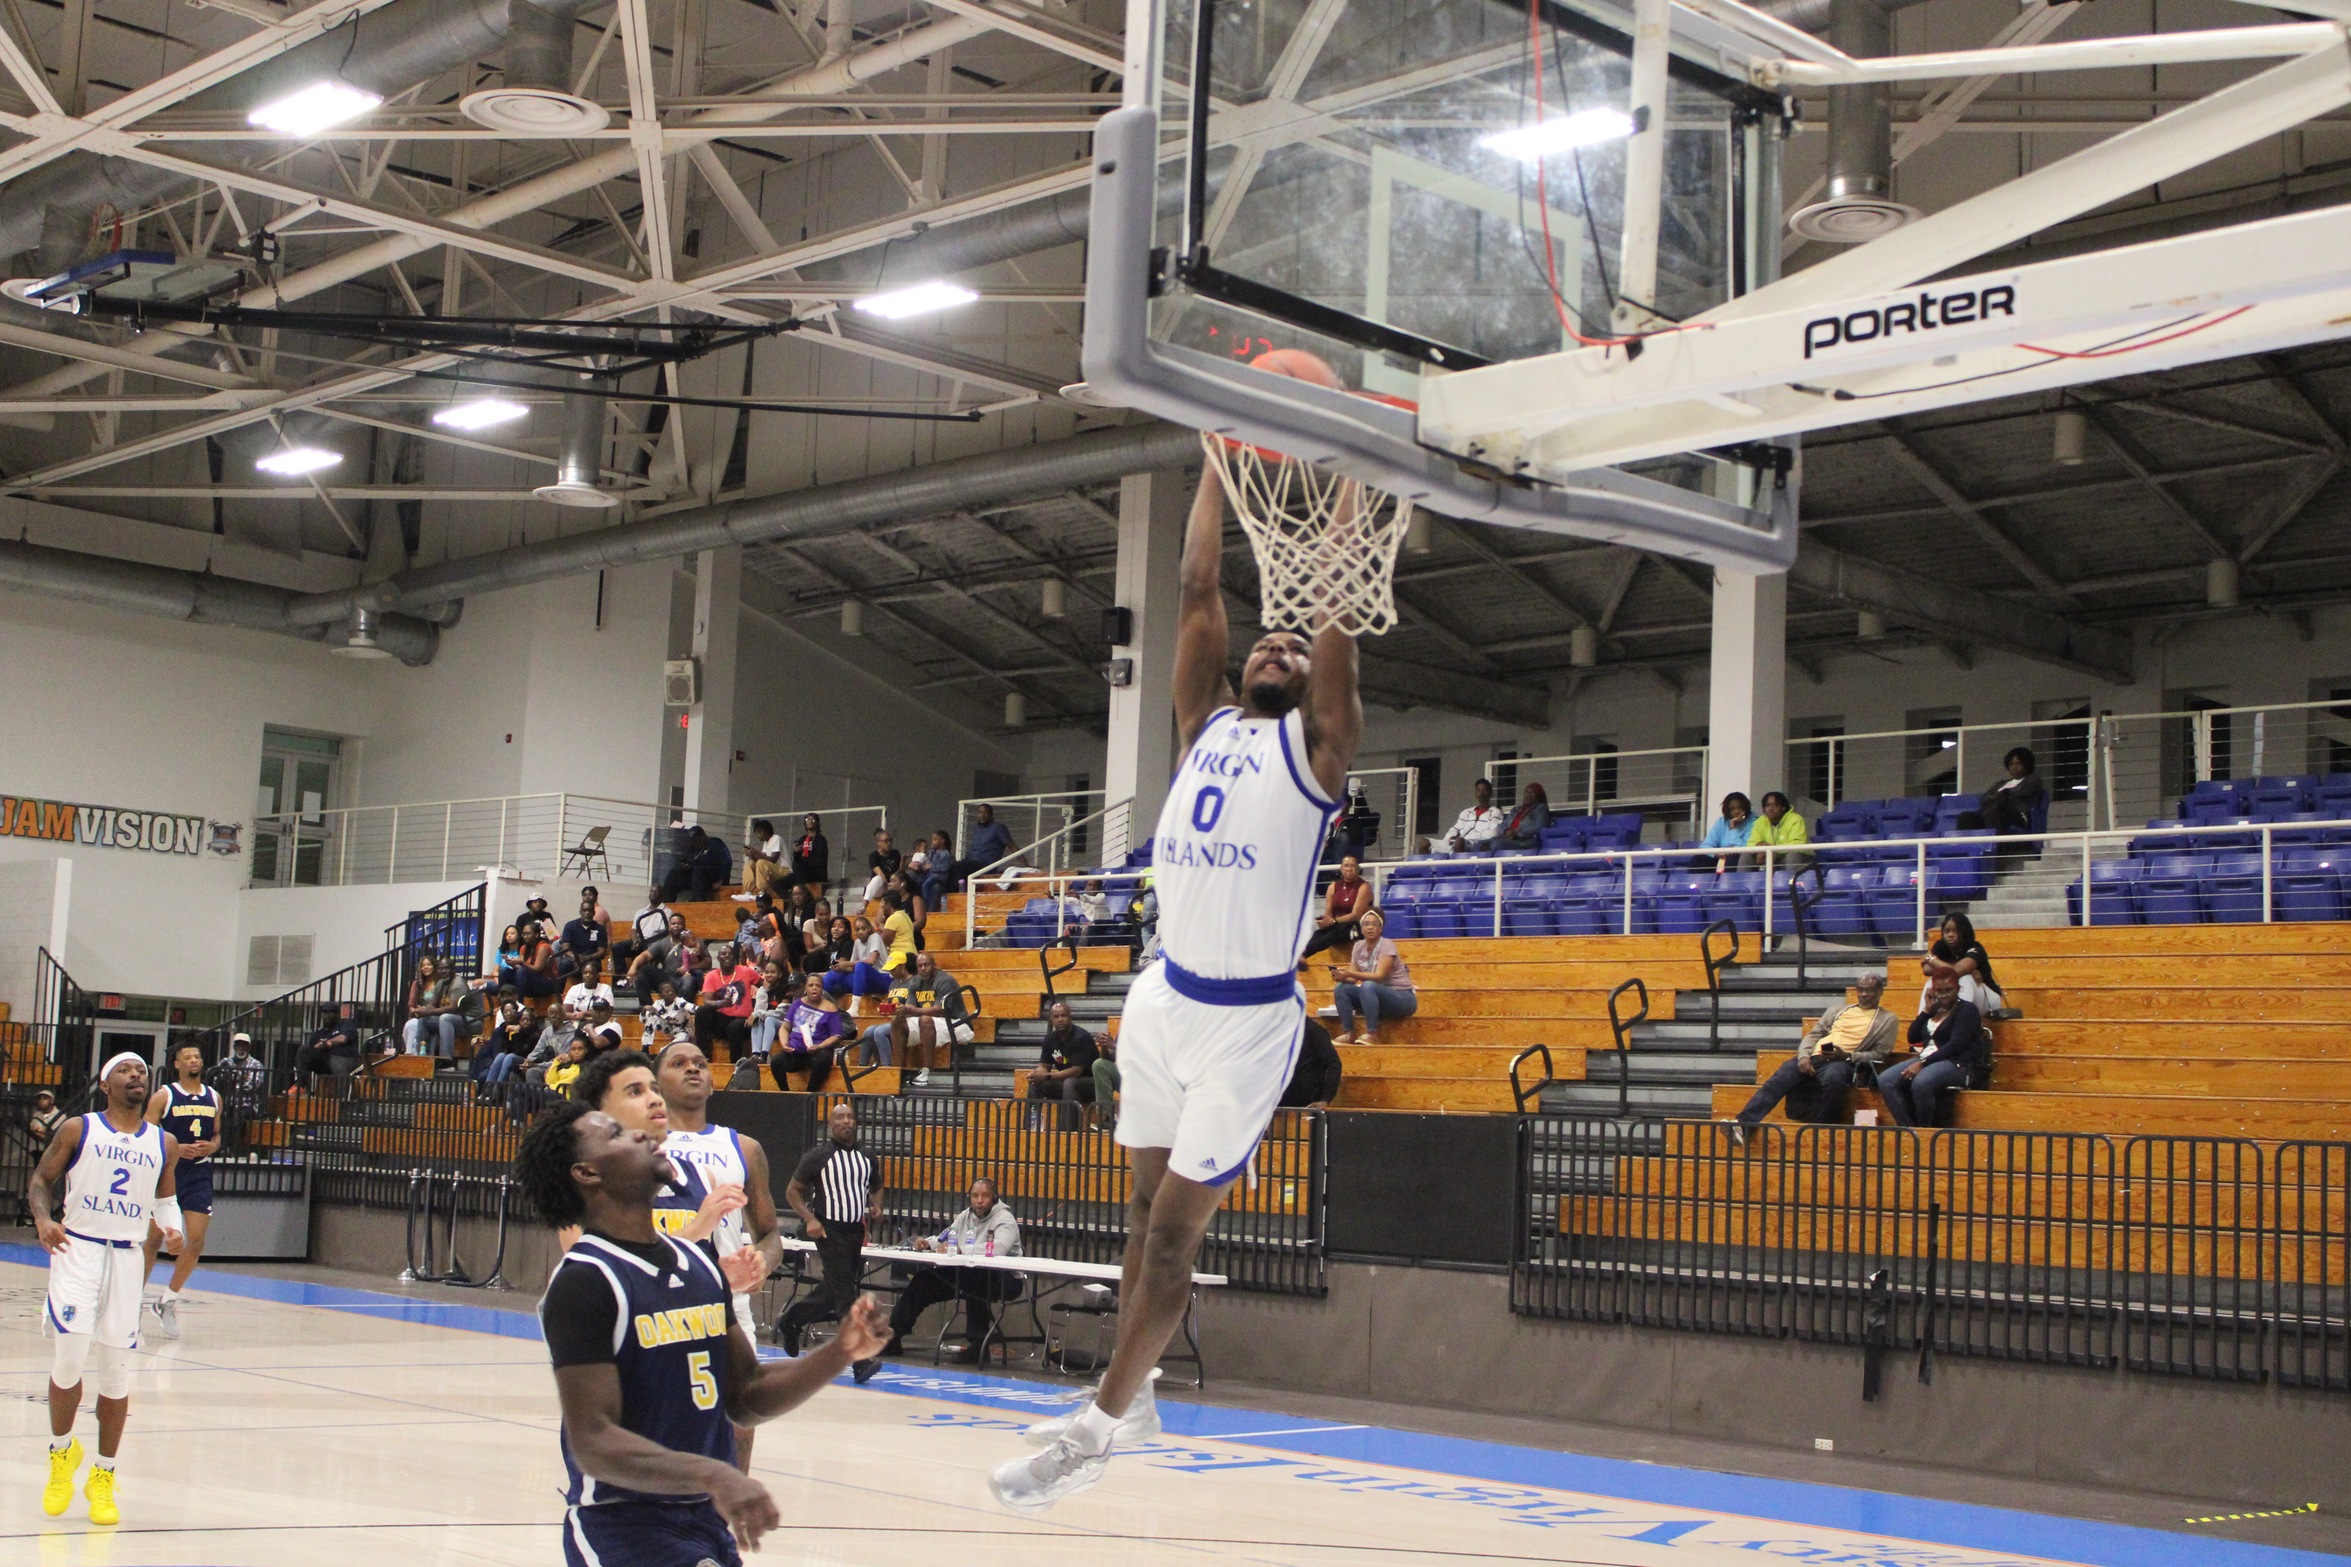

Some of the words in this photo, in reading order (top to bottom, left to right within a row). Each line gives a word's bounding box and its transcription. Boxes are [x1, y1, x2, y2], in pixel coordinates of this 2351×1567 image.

[1192, 785, 1225, 833] 0
[189, 1118, 202, 1137] 4
[94, 1144, 157, 1169] VIRGIN
[110, 1167, 131, 1196] 2
[687, 1350, 719, 1411] 5
